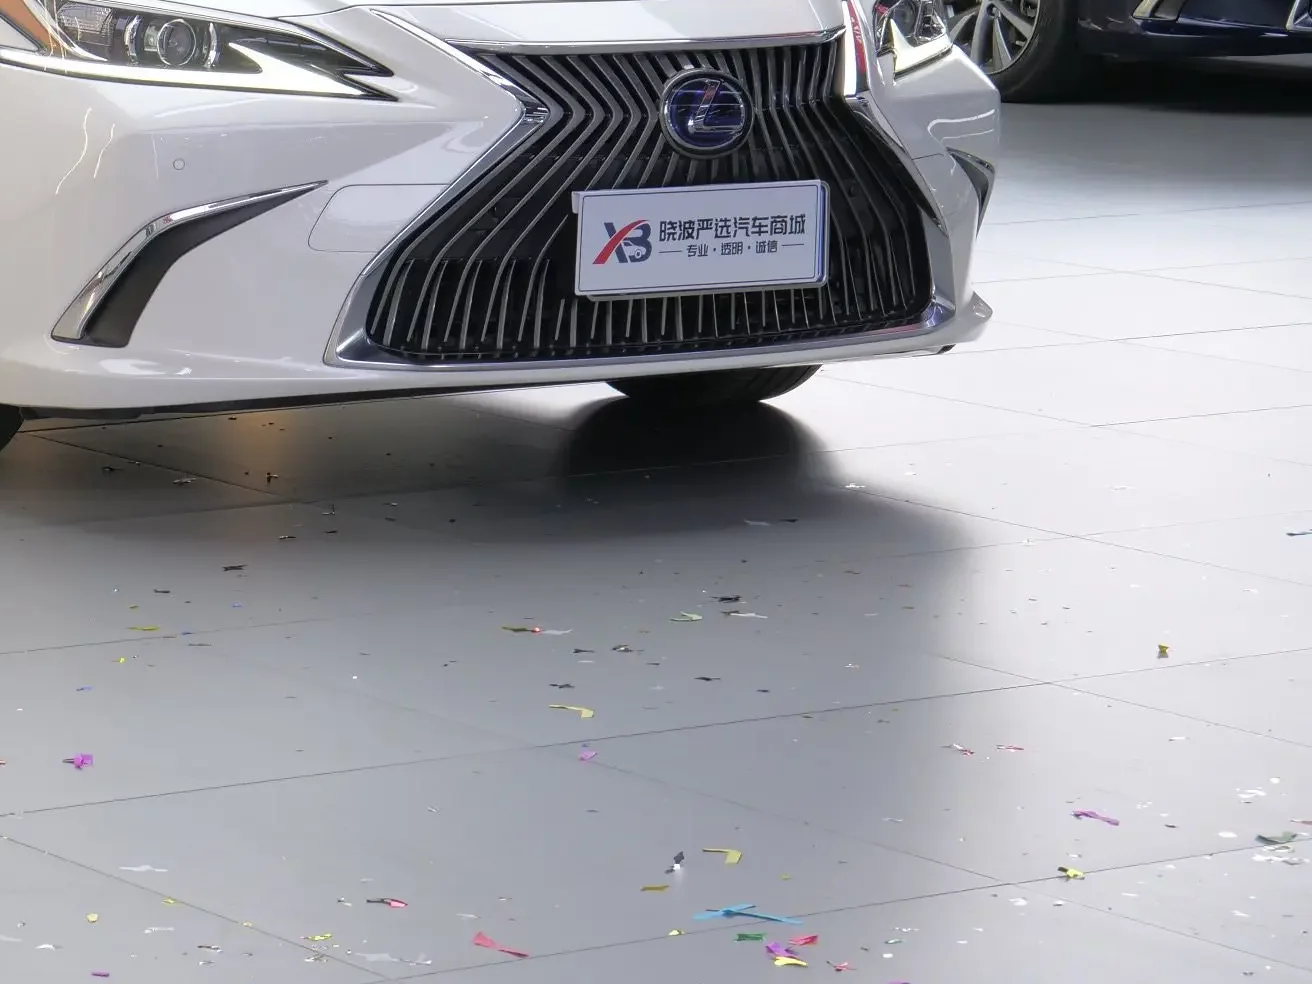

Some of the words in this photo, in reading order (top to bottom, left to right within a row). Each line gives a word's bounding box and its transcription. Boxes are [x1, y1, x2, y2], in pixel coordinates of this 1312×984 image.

[658, 213, 806, 242] 晓波严选汽车商城
